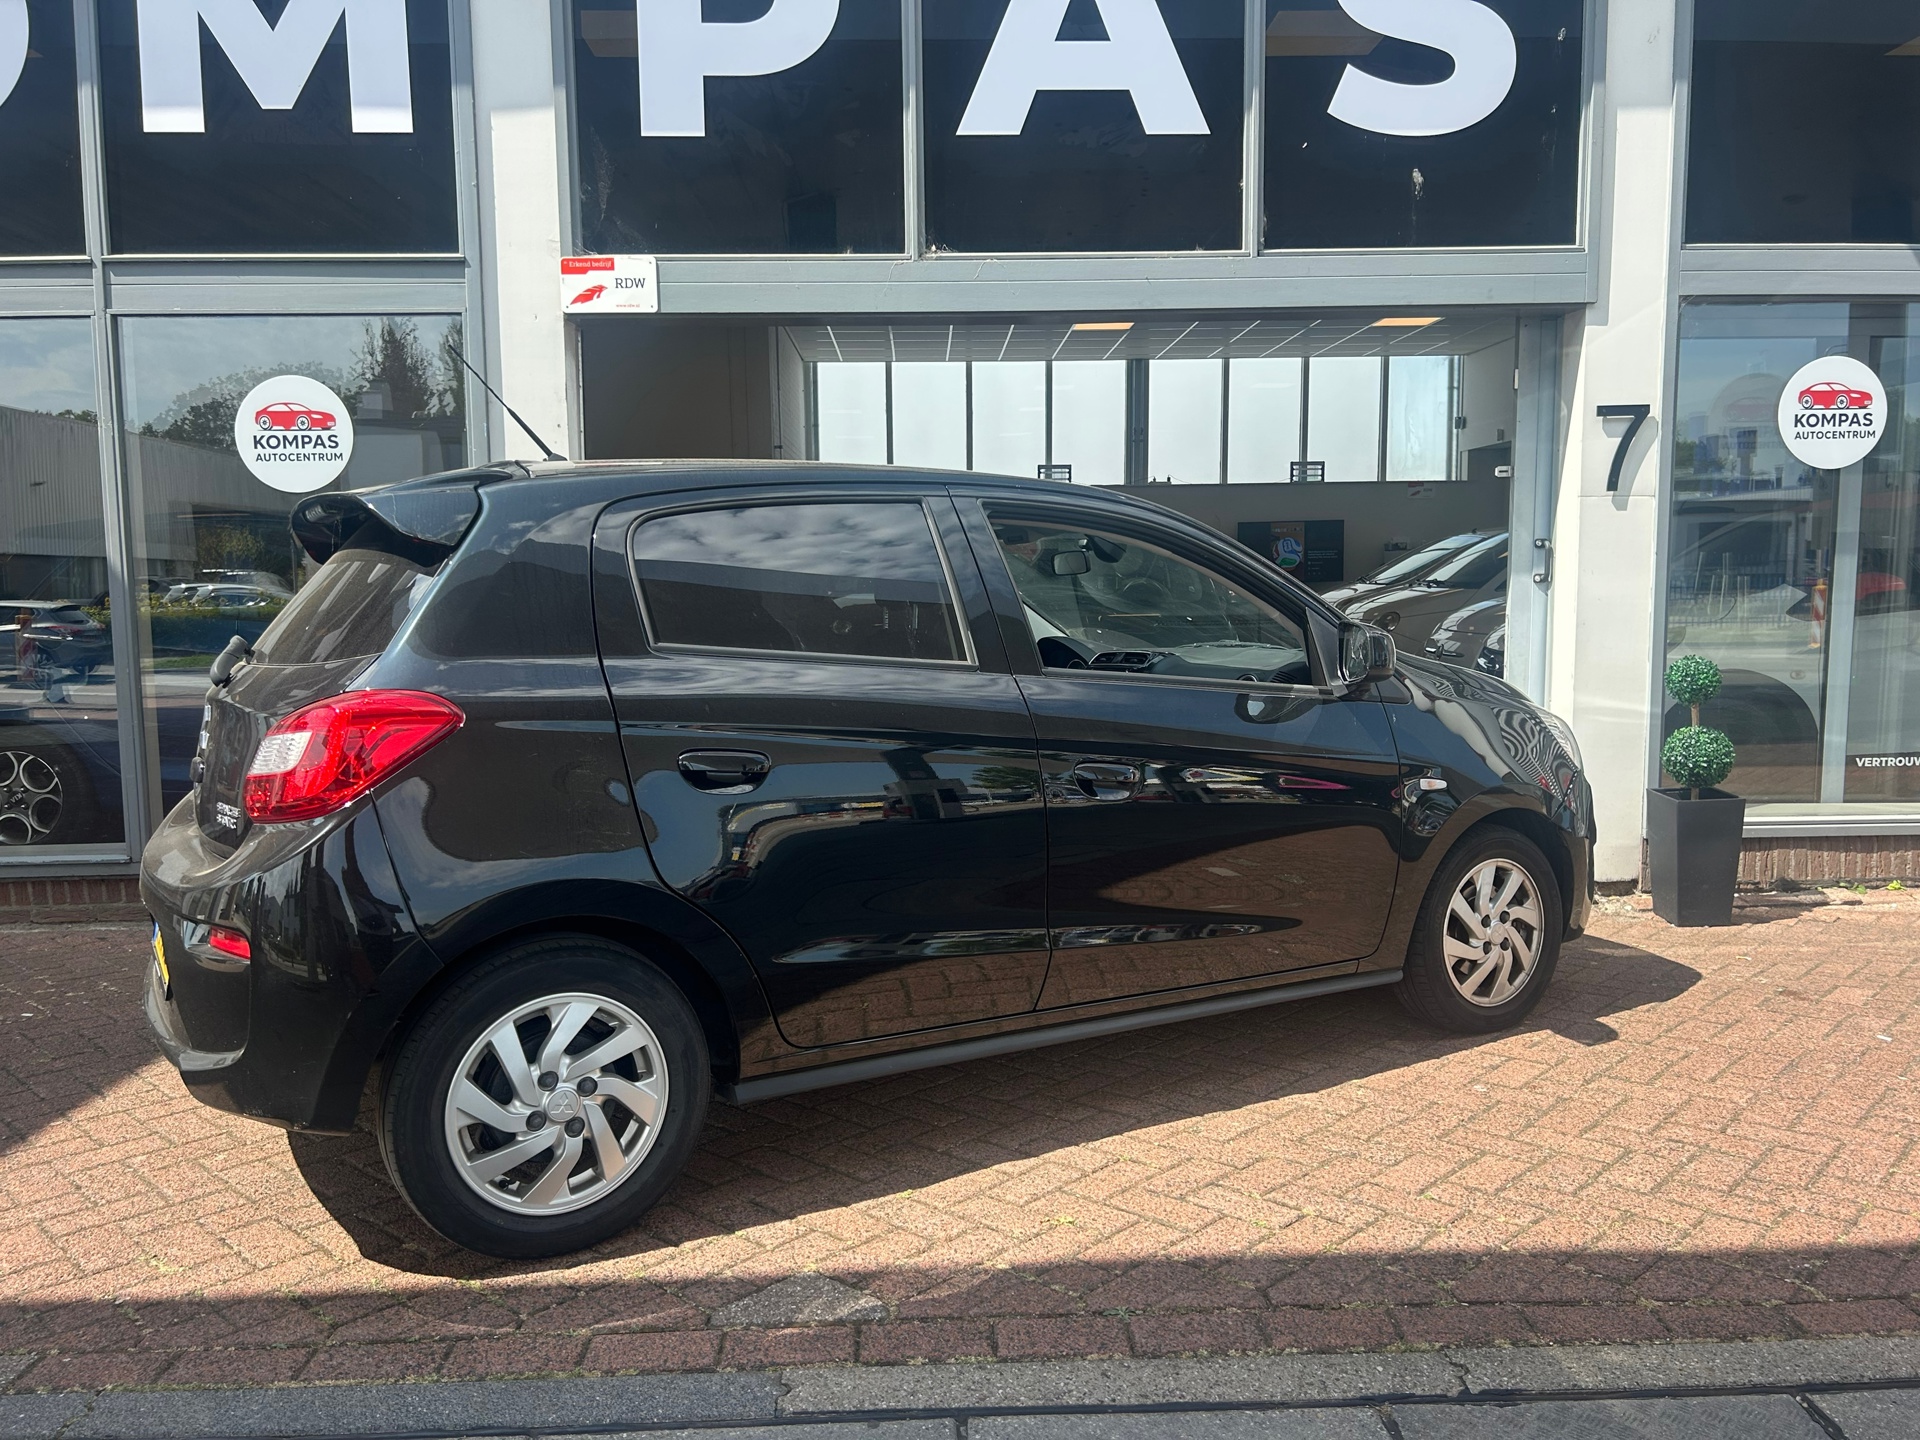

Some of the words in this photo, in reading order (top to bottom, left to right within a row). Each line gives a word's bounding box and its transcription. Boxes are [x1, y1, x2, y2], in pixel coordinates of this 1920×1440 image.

[0, 0, 1516, 136] MPAS
[569, 260, 591, 268] Erkend
[591, 260, 612, 268] bedrijf
[615, 277, 646, 289] RDW
[1793, 412, 1874, 428] KOMPAS
[252, 434, 340, 450] KOMPAS
[1794, 430, 1876, 440] AUTOCENTRUM
[1596, 404, 1650, 492] 7
[255, 452, 344, 463] AUTOCENTRUM
